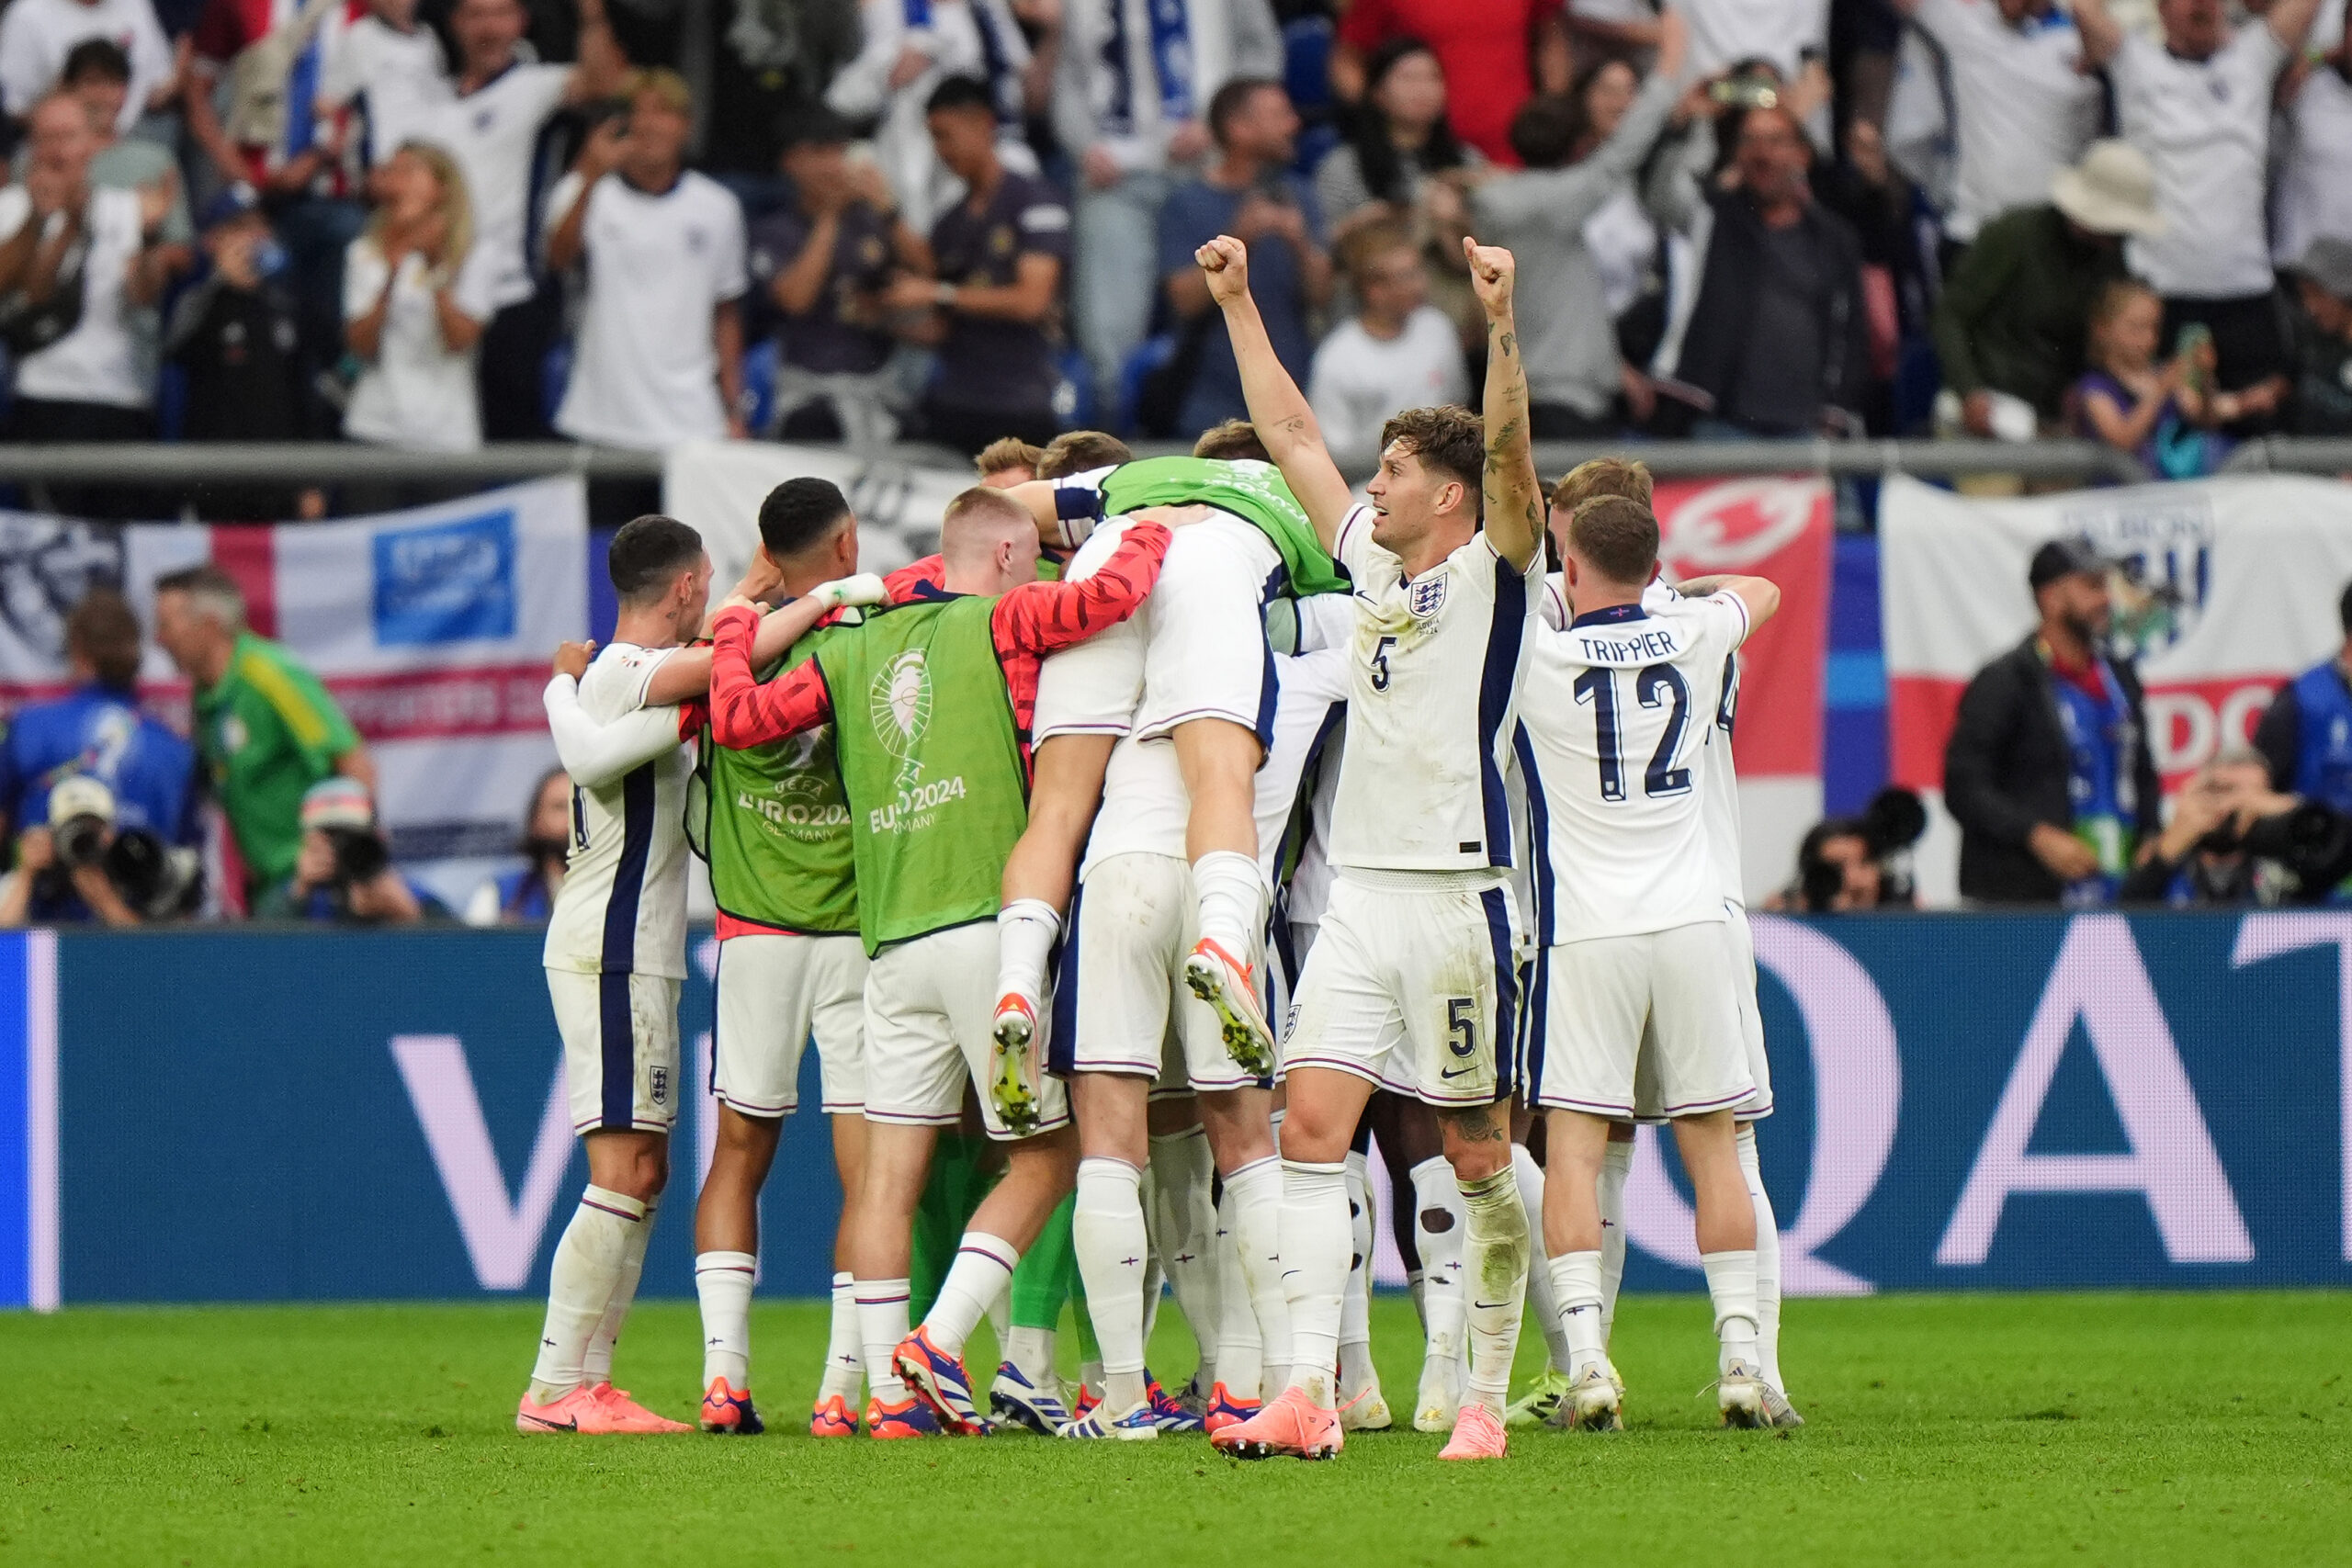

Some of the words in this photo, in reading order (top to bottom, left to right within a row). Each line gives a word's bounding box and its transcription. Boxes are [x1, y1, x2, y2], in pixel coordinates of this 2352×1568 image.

[1371, 636, 1397, 693] 5
[1579, 630, 1679, 662] TRIPPIER
[1573, 661, 1693, 803] 12
[775, 779, 823, 798] UEFA
[869, 775, 967, 834] EUO2024
[762, 819, 835, 841] GEMANY
[1447, 997, 1477, 1058] 5
